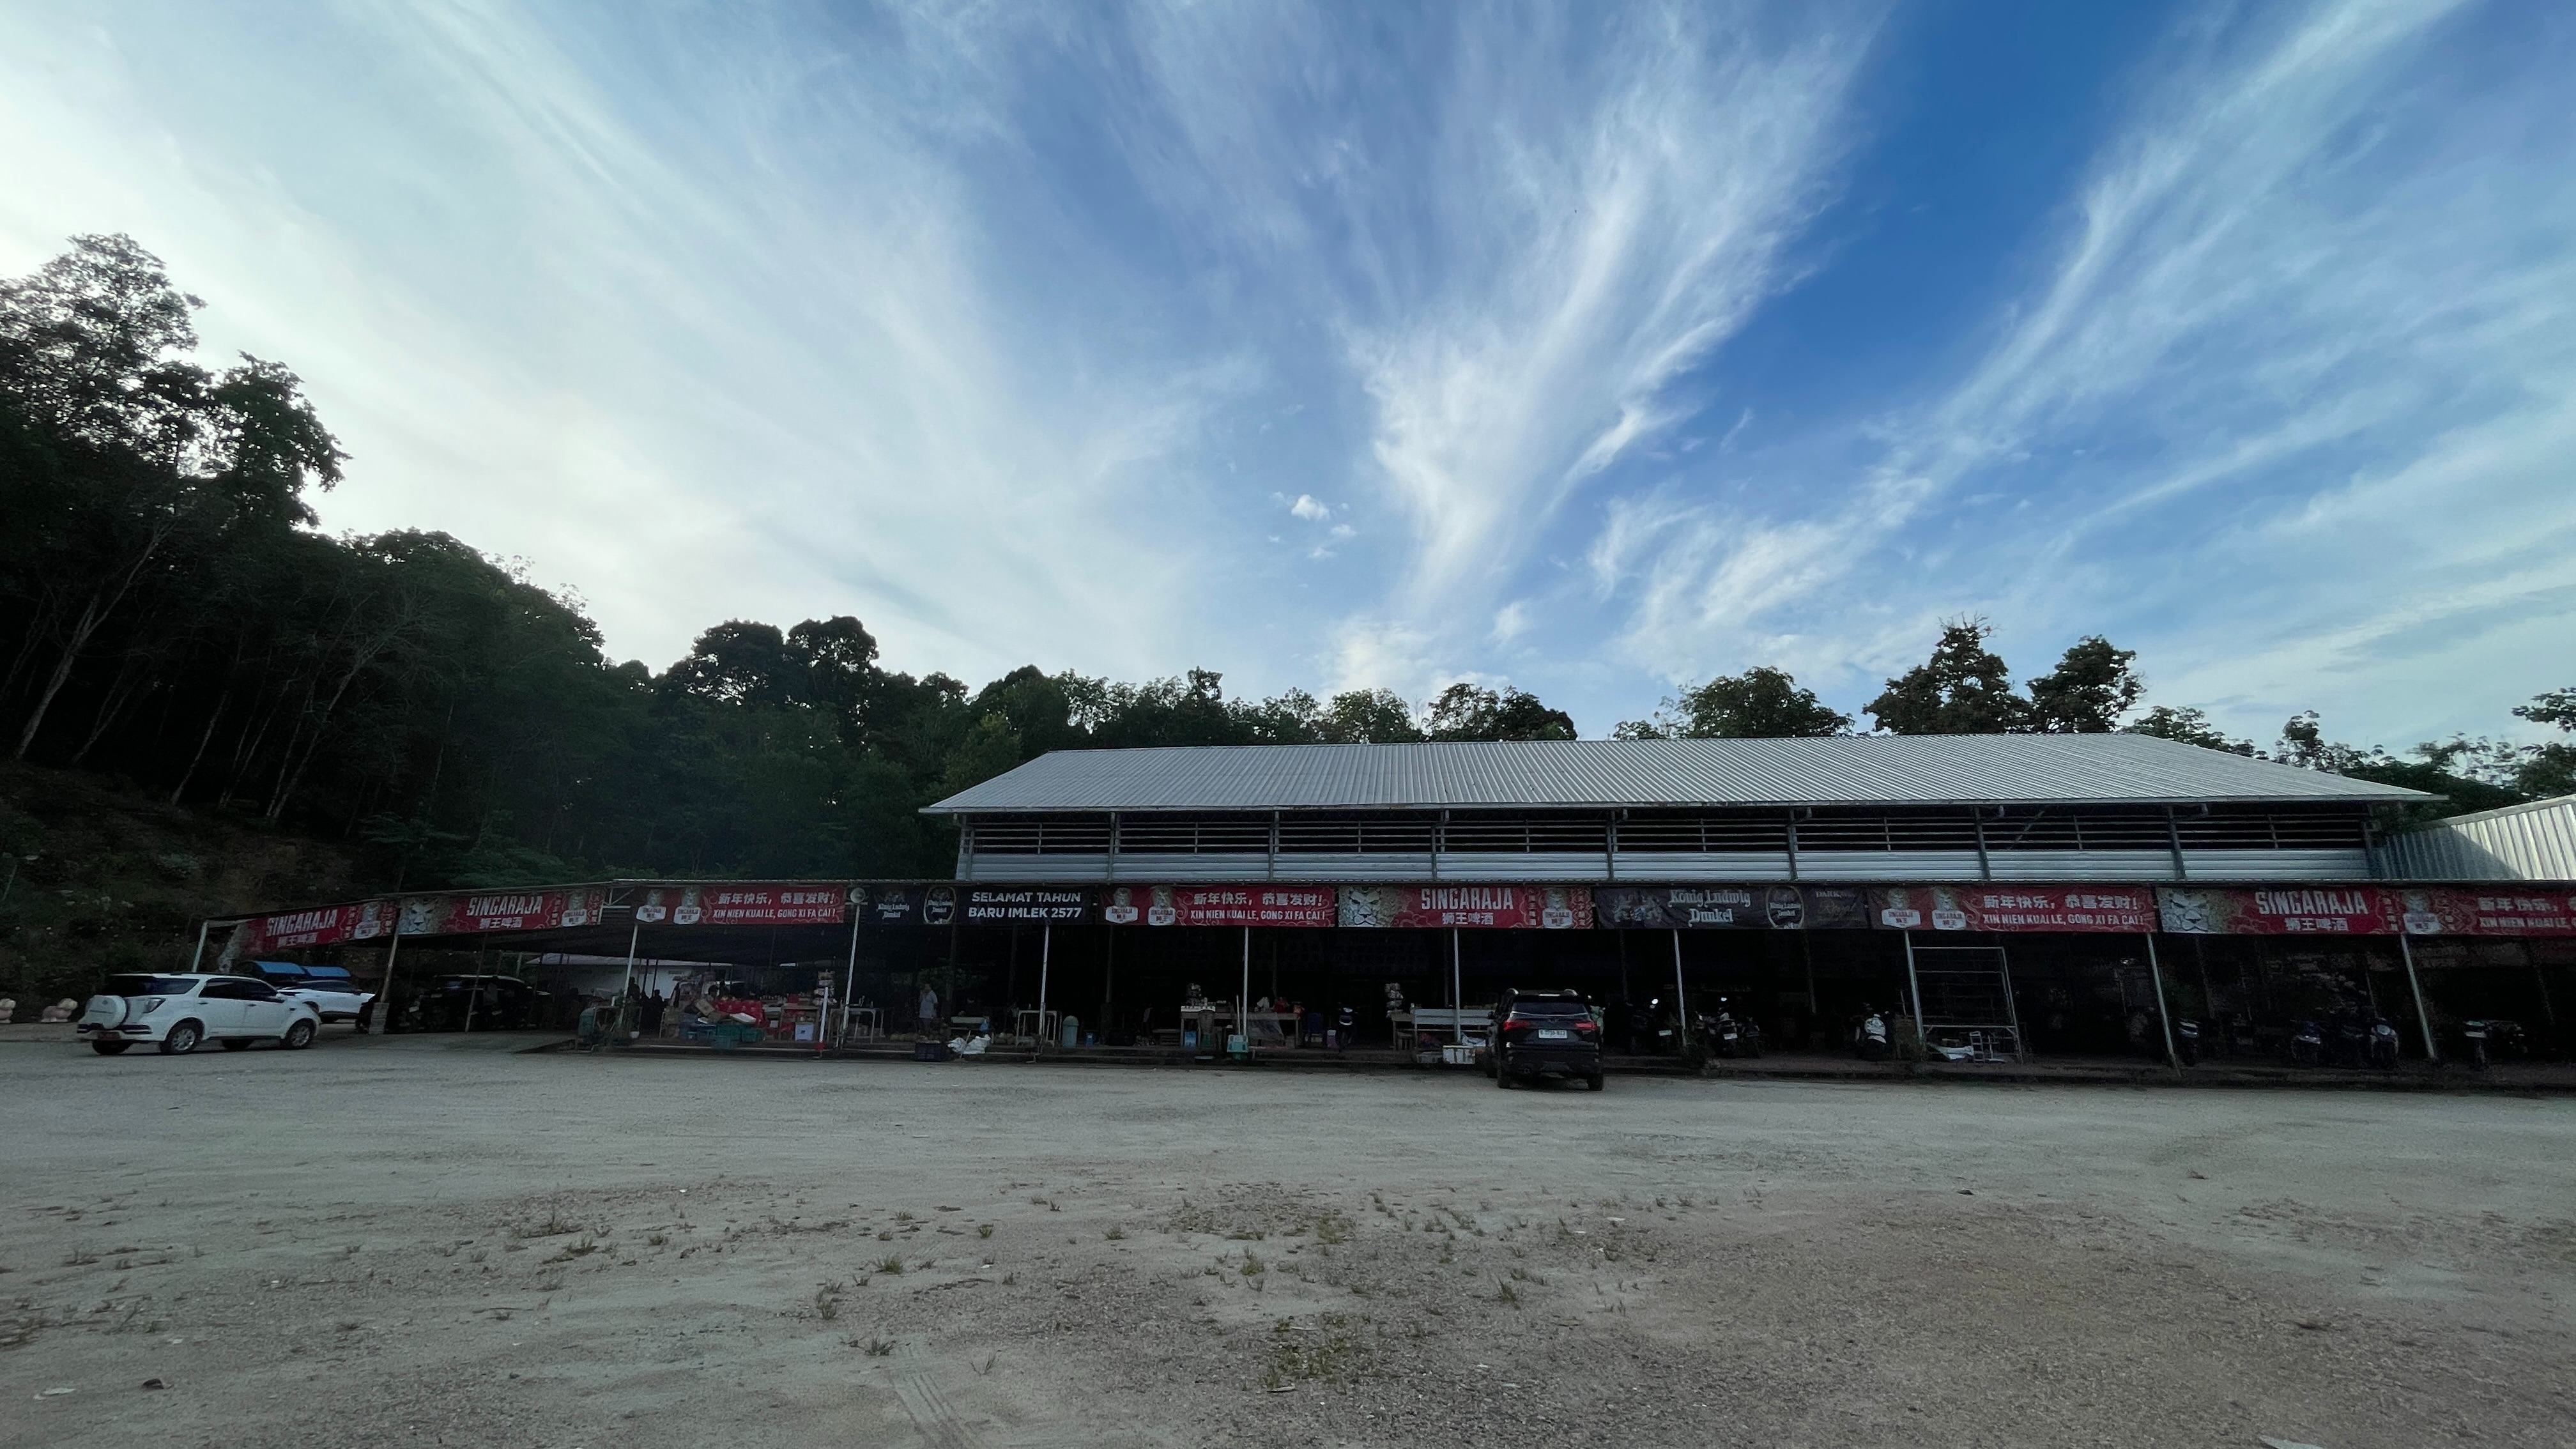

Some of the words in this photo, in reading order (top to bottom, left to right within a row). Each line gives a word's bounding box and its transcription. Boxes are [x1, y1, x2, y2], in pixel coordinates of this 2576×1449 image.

[972, 892, 1033, 902] SELAMAT
[1037, 893, 1081, 902] TAHUN
[1421, 887, 1514, 910] SINGARAJA
[1704, 889, 1751, 908] Ludwig
[2255, 890, 2368, 914] SINGARAJA
[466, 896, 542, 916] SINGARAJA
[713, 909, 726, 918] XIN
[727, 909, 744, 918] NIEN
[746, 909, 764, 917] KUAI
[778, 908, 797, 917] GONG
[798, 908, 806, 917] XI
[808, 908, 816, 917] FA
[968, 907, 1005, 917] BARU
[1008, 907, 1048, 917] IMLEK
[1050, 907, 1082, 917] 2577
[1190, 910, 1204, 919] XIN
[1206, 910, 1225, 919] NIEN
[1227, 910, 1245, 919] KUAI
[1261, 910, 1283, 919] GONG
[1285, 910, 1292, 919] XI
[1294, 910, 1305, 919] FA
[1442, 912, 1494, 925] 狮王啤酒
[1687, 908, 1734, 927] Dunkel
[1983, 914, 2000, 924] XIN
[2002, 914, 2025, 924] NIEN
[2027, 914, 2049, 924] KUAI
[2067, 914, 2093, 924] GONG
[2095, 914, 2106, 924] XI
[2108, 915, 2119, 924] FA
[266, 909, 337, 937] SINGARAJA
